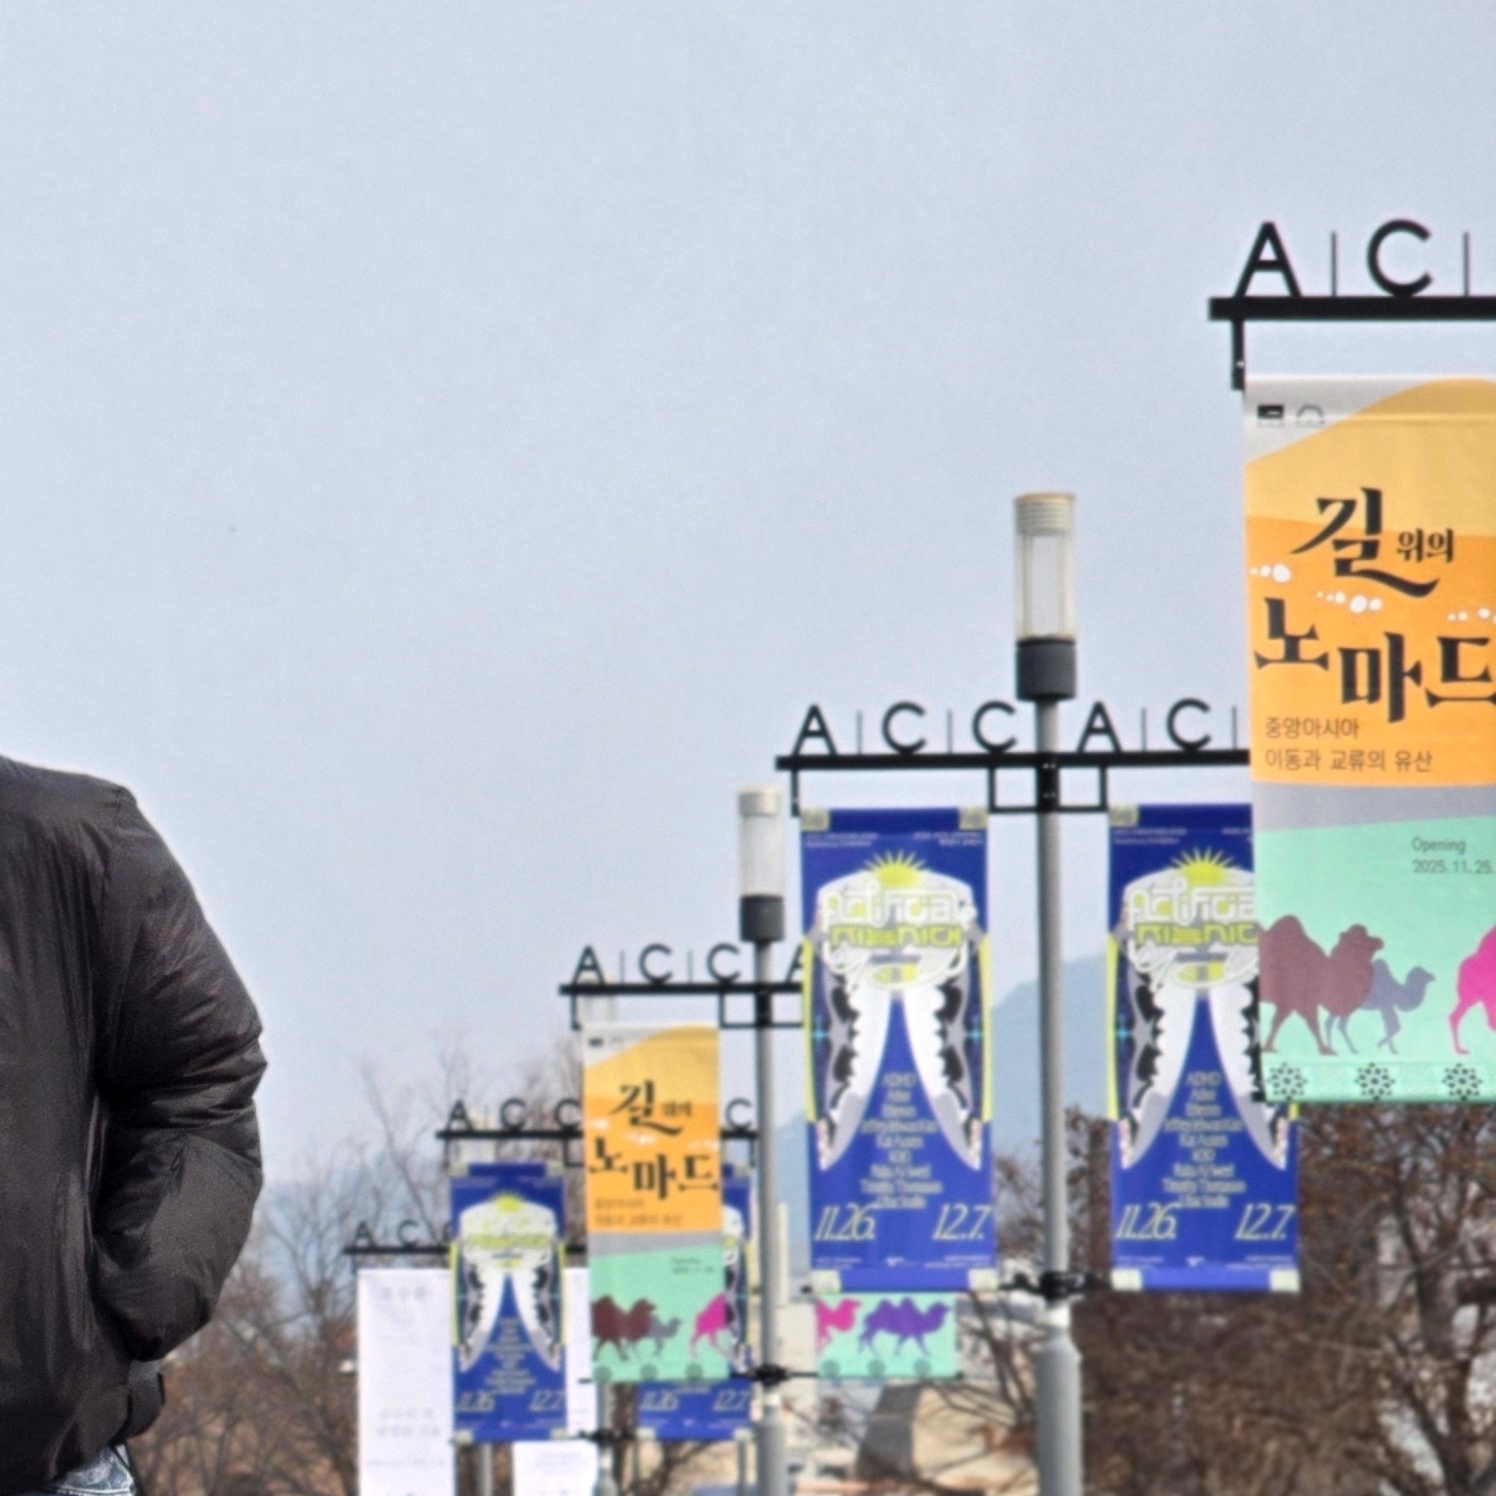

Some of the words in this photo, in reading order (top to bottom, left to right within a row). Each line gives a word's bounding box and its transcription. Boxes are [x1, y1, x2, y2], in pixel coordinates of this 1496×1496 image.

[1233, 218, 1433, 298] AC
[1290, 486, 1441, 599] 길
[1396, 528, 1455, 564] 위의
[1254, 596, 1496, 724] 노마드
[1076, 698, 1211, 753] AC
[1265, 716, 1359, 739] 중앙아시아
[1265, 749, 1321, 771] 이동과
[1330, 750, 1386, 771] 교류의
[1394, 750, 1433, 773] 유산
[1412, 836, 1467, 854] Opening
[610, 1079, 683, 1136] 길
[588, 1137, 718, 1200] 노마드
